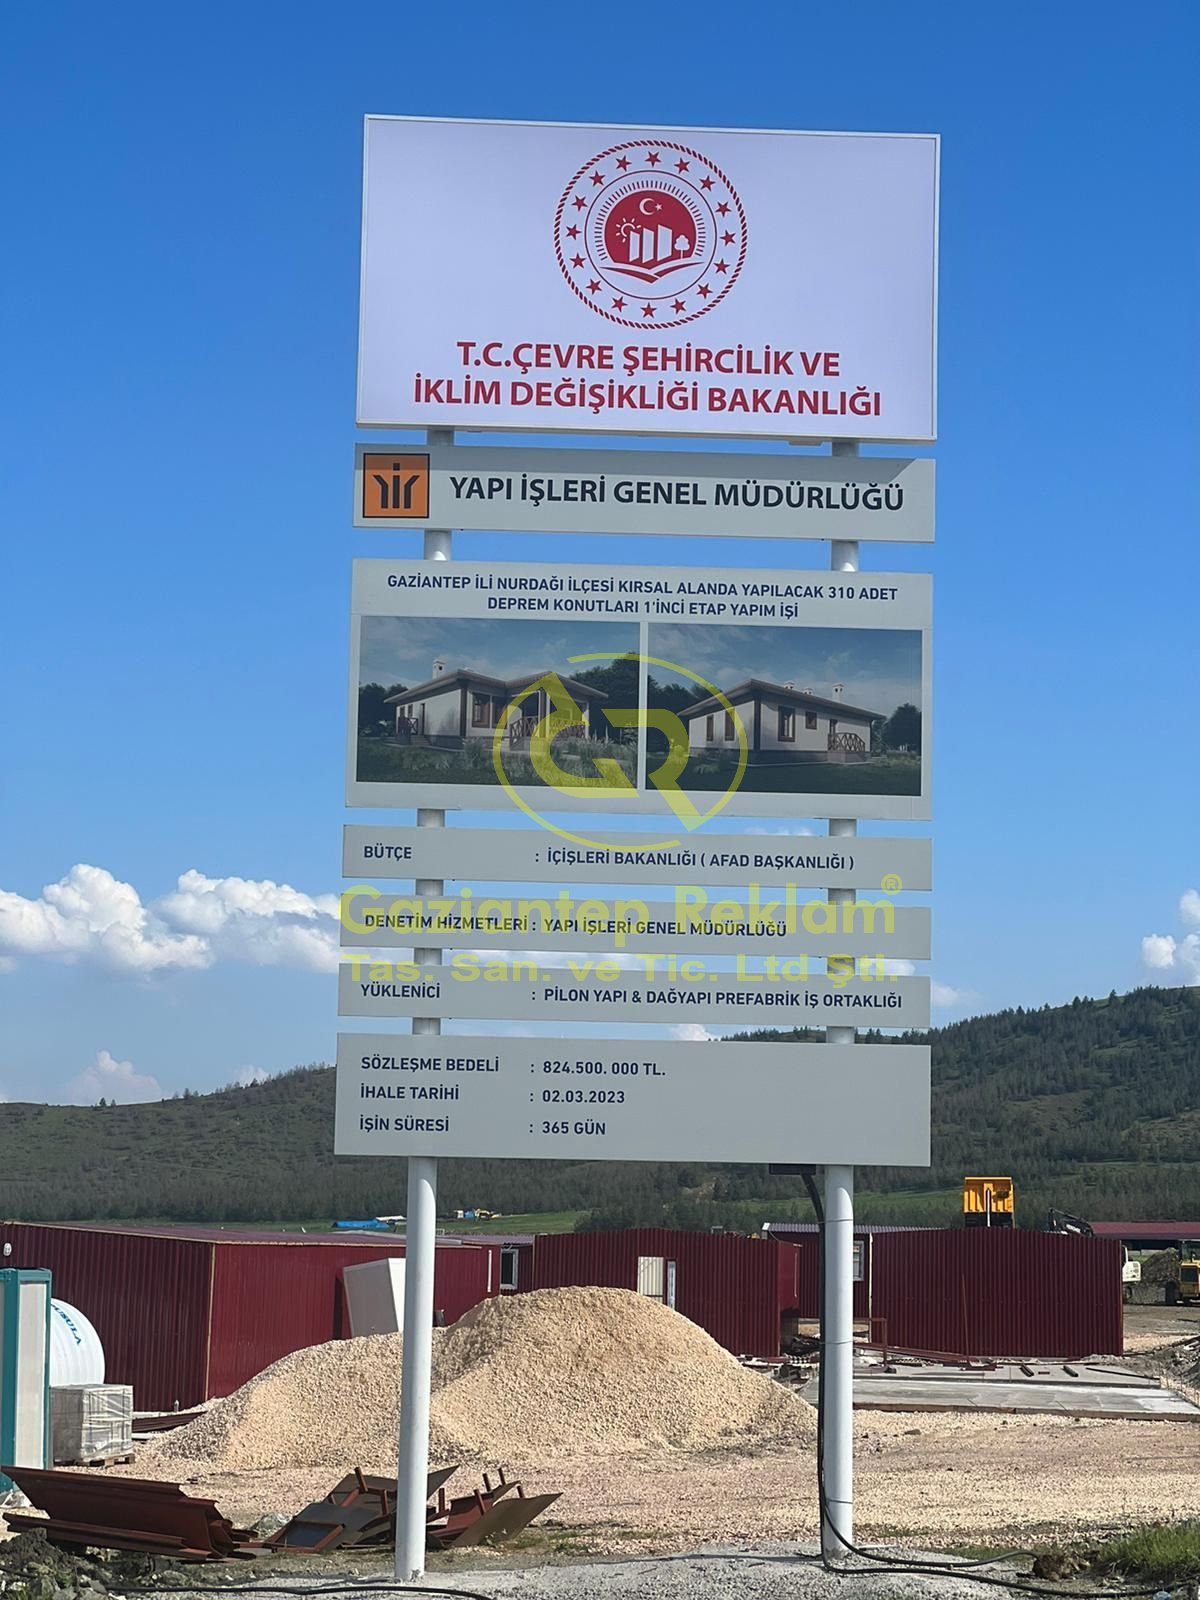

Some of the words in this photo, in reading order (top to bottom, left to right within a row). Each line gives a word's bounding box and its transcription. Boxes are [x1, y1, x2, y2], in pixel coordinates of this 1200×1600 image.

[623, 342, 793, 377] ŞEHİRCİLİK
[800, 352, 840, 377] VE
[414, 373, 500, 404] İKLİM
[510, 377, 698, 414] DEĞİŞİKLİĞİ
[708, 386, 881, 416] BAKANLIĞI
[450, 476, 512, 500] YAPI
[521, 473, 605, 507] İŞLERİ
[613, 480, 707, 505] GENEL
[714, 479, 904, 510] MÜDÜRLÜĞÜ
[387, 573, 470, 589] GAZİANTEP
[475, 574, 493, 590] İLİ
[497, 576, 563, 591] NURDAĞI
[568, 576, 614, 595] İLÇESİ
[619, 580, 672, 594] KIRSAL
[677, 583, 738, 596] ALANDA
[741, 584, 823, 598] YAPILACAK
[828, 586, 855, 599] 310
[859, 587, 898, 600] ADET
[488, 597, 549, 610] DEPREM
[553, 598, 639, 613] KONUTLARI
[644, 598, 684, 614] 1'İNCİ
[689, 602, 727, 615] ETAP
[730, 603, 775, 617] YAPIM
[780, 602, 798, 619] İŞİ
[363, 843, 412, 862] BÜTÇE
[547, 848, 610, 865] İÇİŞLERİ
[614, 850, 696, 866] BAKANLIĞI
[709, 854, 750, 867] AFAD
[754, 853, 845, 871] BAŞKANLIĞI
[365, 912, 432, 929] DENETİM
[437, 913, 528, 931] HİZMETLERİ
[544, 918, 578, 933] YAPI
[583, 917, 631, 936] İŞLERİ
[636, 921, 686, 935] GENEL
[690, 920, 786, 937] MÜDÜRLÜĞÜ
[360, 982, 440, 999] YÜKLENİCİ
[544, 986, 589, 1002] PİLON
[593, 989, 627, 1003] YAPI
[631, 990, 642, 1003] &
[647, 988, 711, 1004] DAĞYAPI
[716, 990, 800, 1006] PREFABRİK
[804, 990, 819, 1008] İŞ
[823, 992, 902, 1008] ORTAKLIĞI
[361, 1054, 442, 1073] SÖZLEŞME
[446, 1057, 499, 1072] BEDELİ
[644, 1063, 666, 1076] TL.
[360, 1083, 405, 1099] İHALE
[410, 1084, 459, 1100] TARİHİ
[542, 1090, 625, 1103] 02.03.2023
[360, 1115, 389, 1133] İŞİN
[394, 1115, 449, 1132] SÜRESİ
[542, 1121, 569, 1134] 365
[573, 1118, 606, 1135] GÜN
